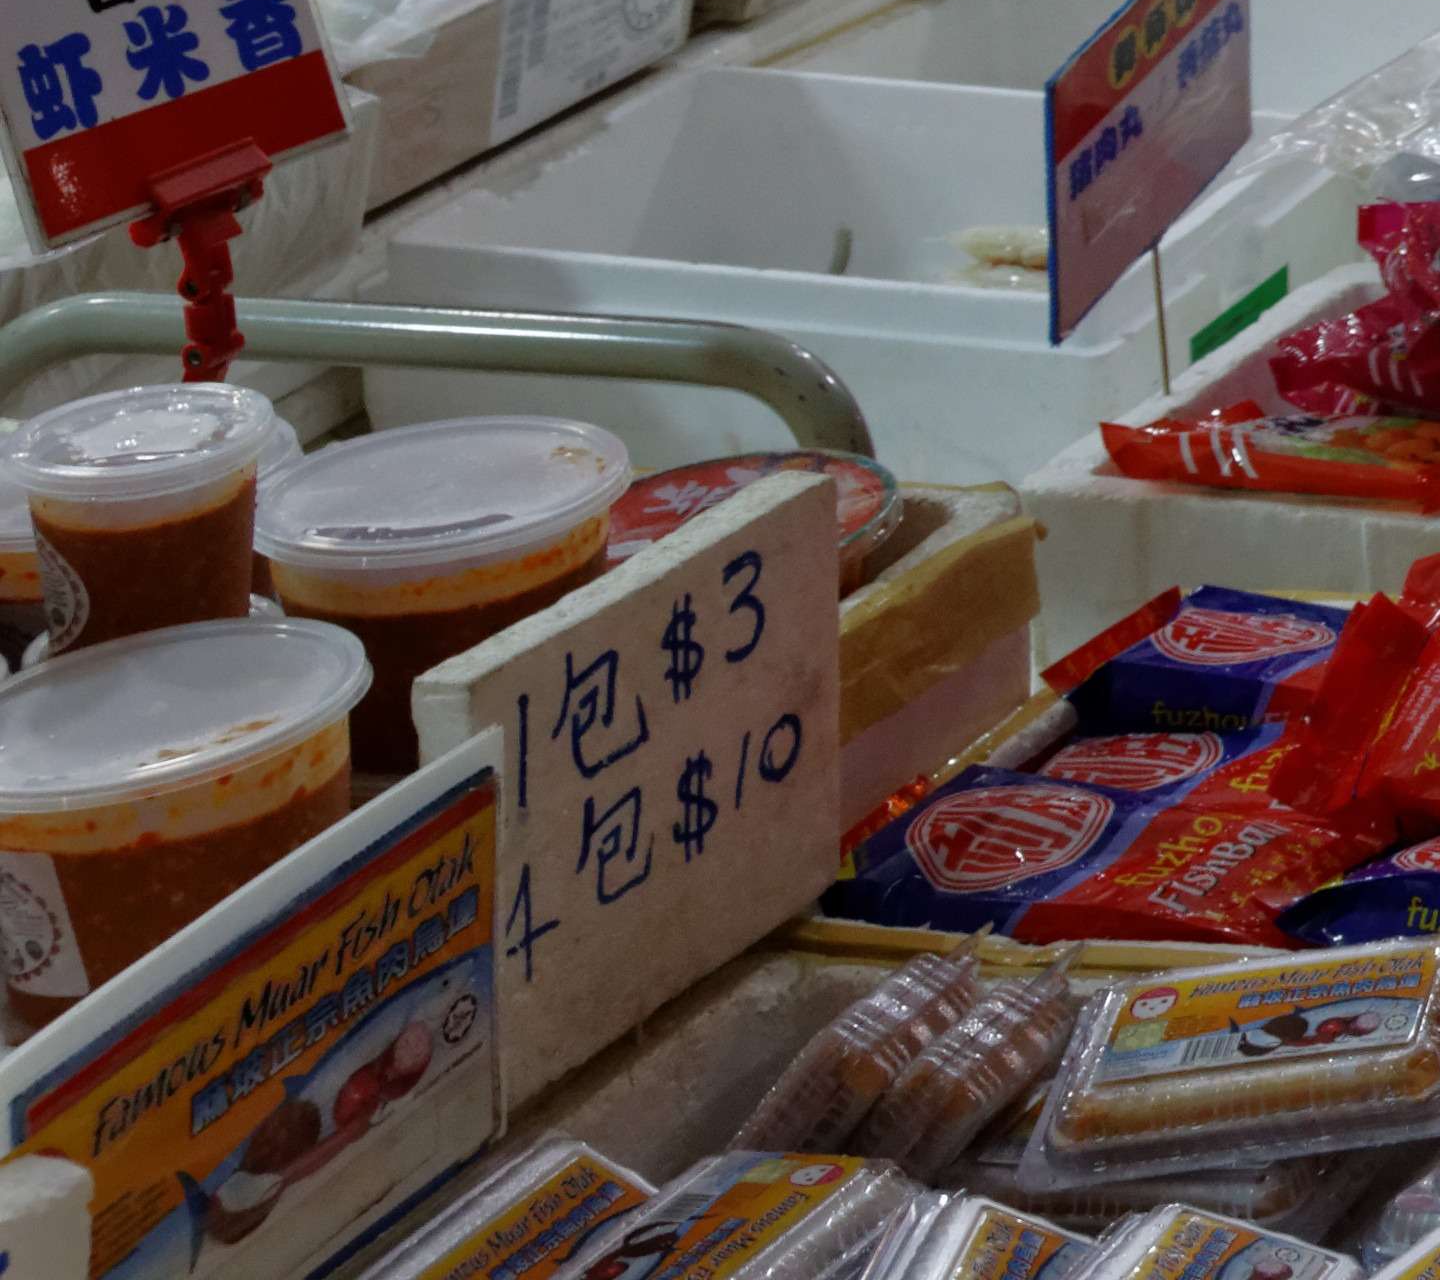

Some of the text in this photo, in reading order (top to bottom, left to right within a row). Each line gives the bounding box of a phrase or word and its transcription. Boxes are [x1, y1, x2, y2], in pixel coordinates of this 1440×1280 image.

[660, 550, 768, 705] $3
[672, 711, 803, 865] $10
[93, 831, 476, 1158] Famous Muar Fish Otak
